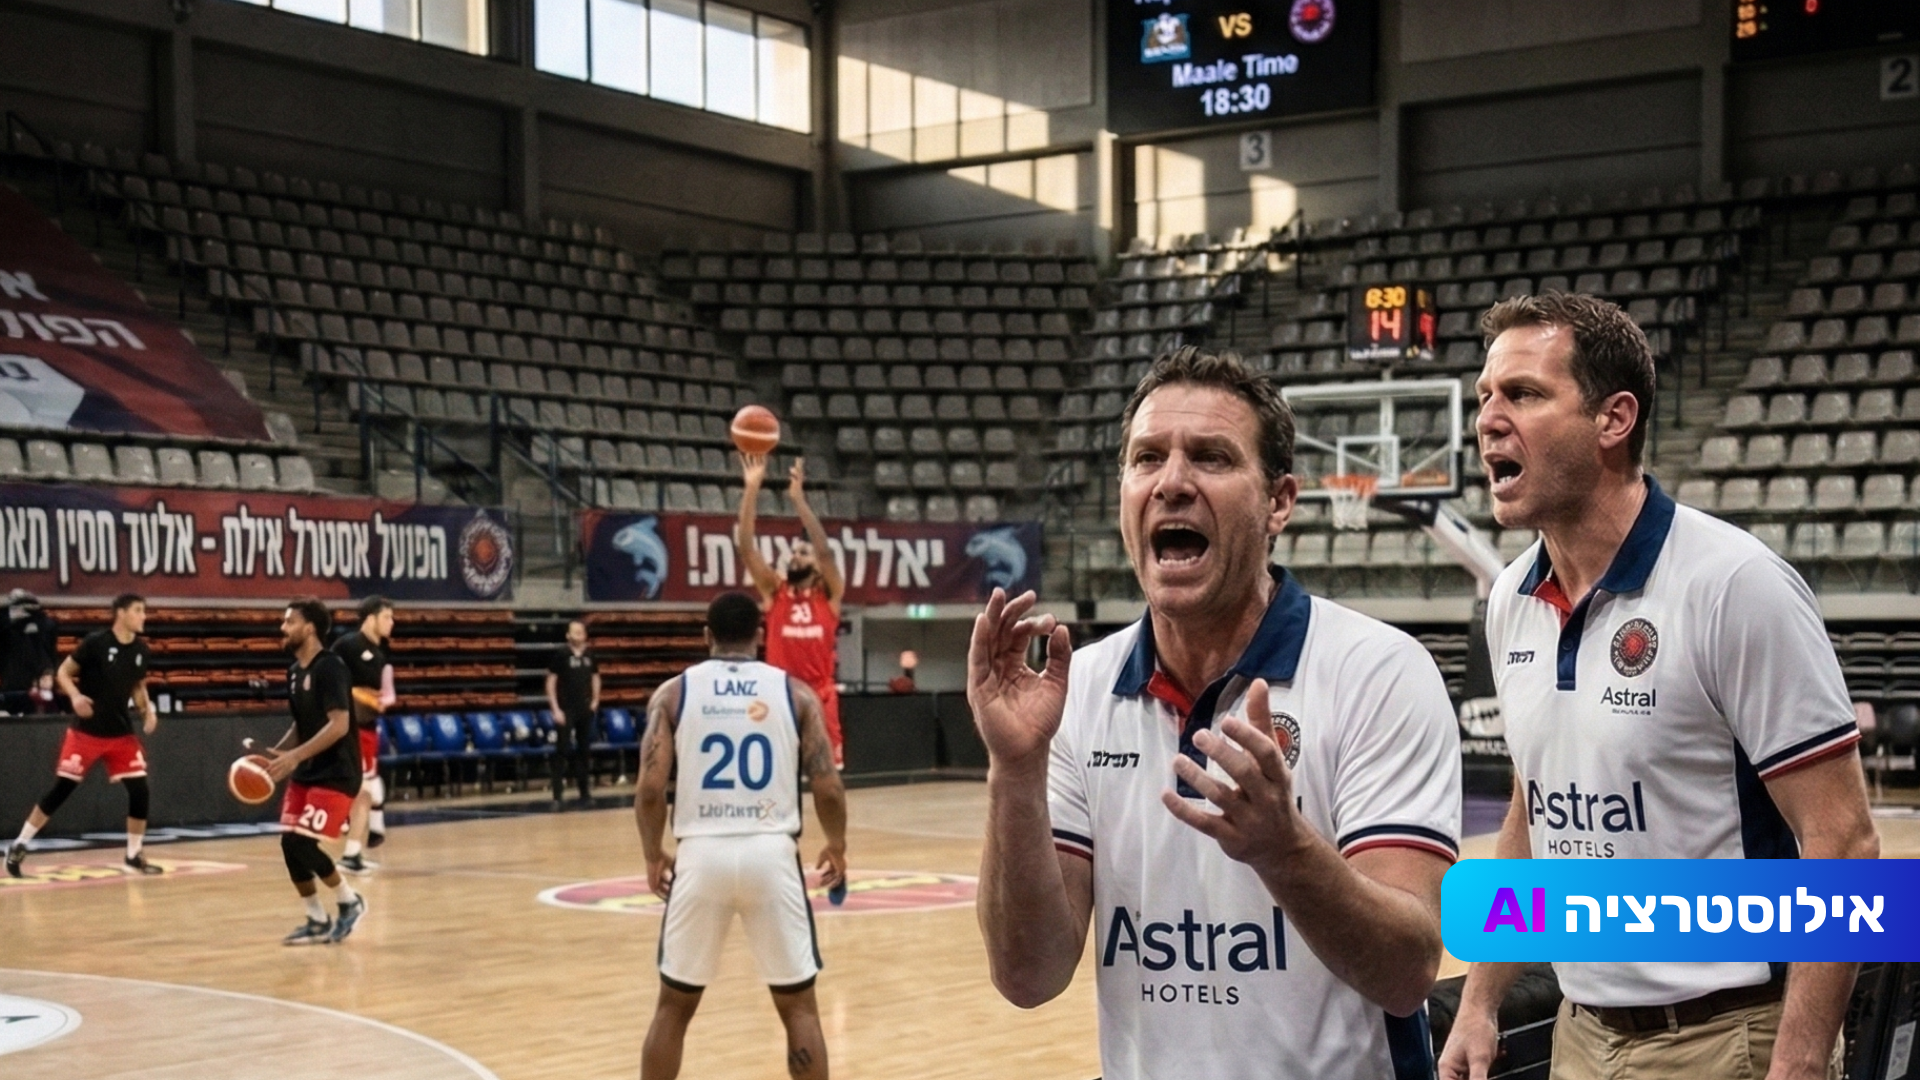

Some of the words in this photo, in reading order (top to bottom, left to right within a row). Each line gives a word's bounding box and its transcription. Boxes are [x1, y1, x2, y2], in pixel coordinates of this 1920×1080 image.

[1218, 13, 1252, 39] VS
[1172, 59, 1237, 87] Maale
[1887, 57, 1912, 93] 2
[1201, 83, 1271, 116] 18:30
[1249, 134, 1264, 165] 3
[1371, 309, 1401, 340] 14
[56, 508, 118, 586] חסין
[122, 500, 196, 576] אלעד
[222, 504, 285, 577] אילת
[288, 506, 371, 579] אסטרל
[375, 512, 448, 581] הפועל
[1600, 686, 1656, 708] Astral
[700, 732, 773, 792] 20
[299, 803, 329, 831] 20
[1527, 779, 1647, 833] Astral
[1548, 839, 1616, 858] HOTELS
[1102, 905, 1288, 973] Astral
[1141, 983, 1240, 1006] HOTELS
